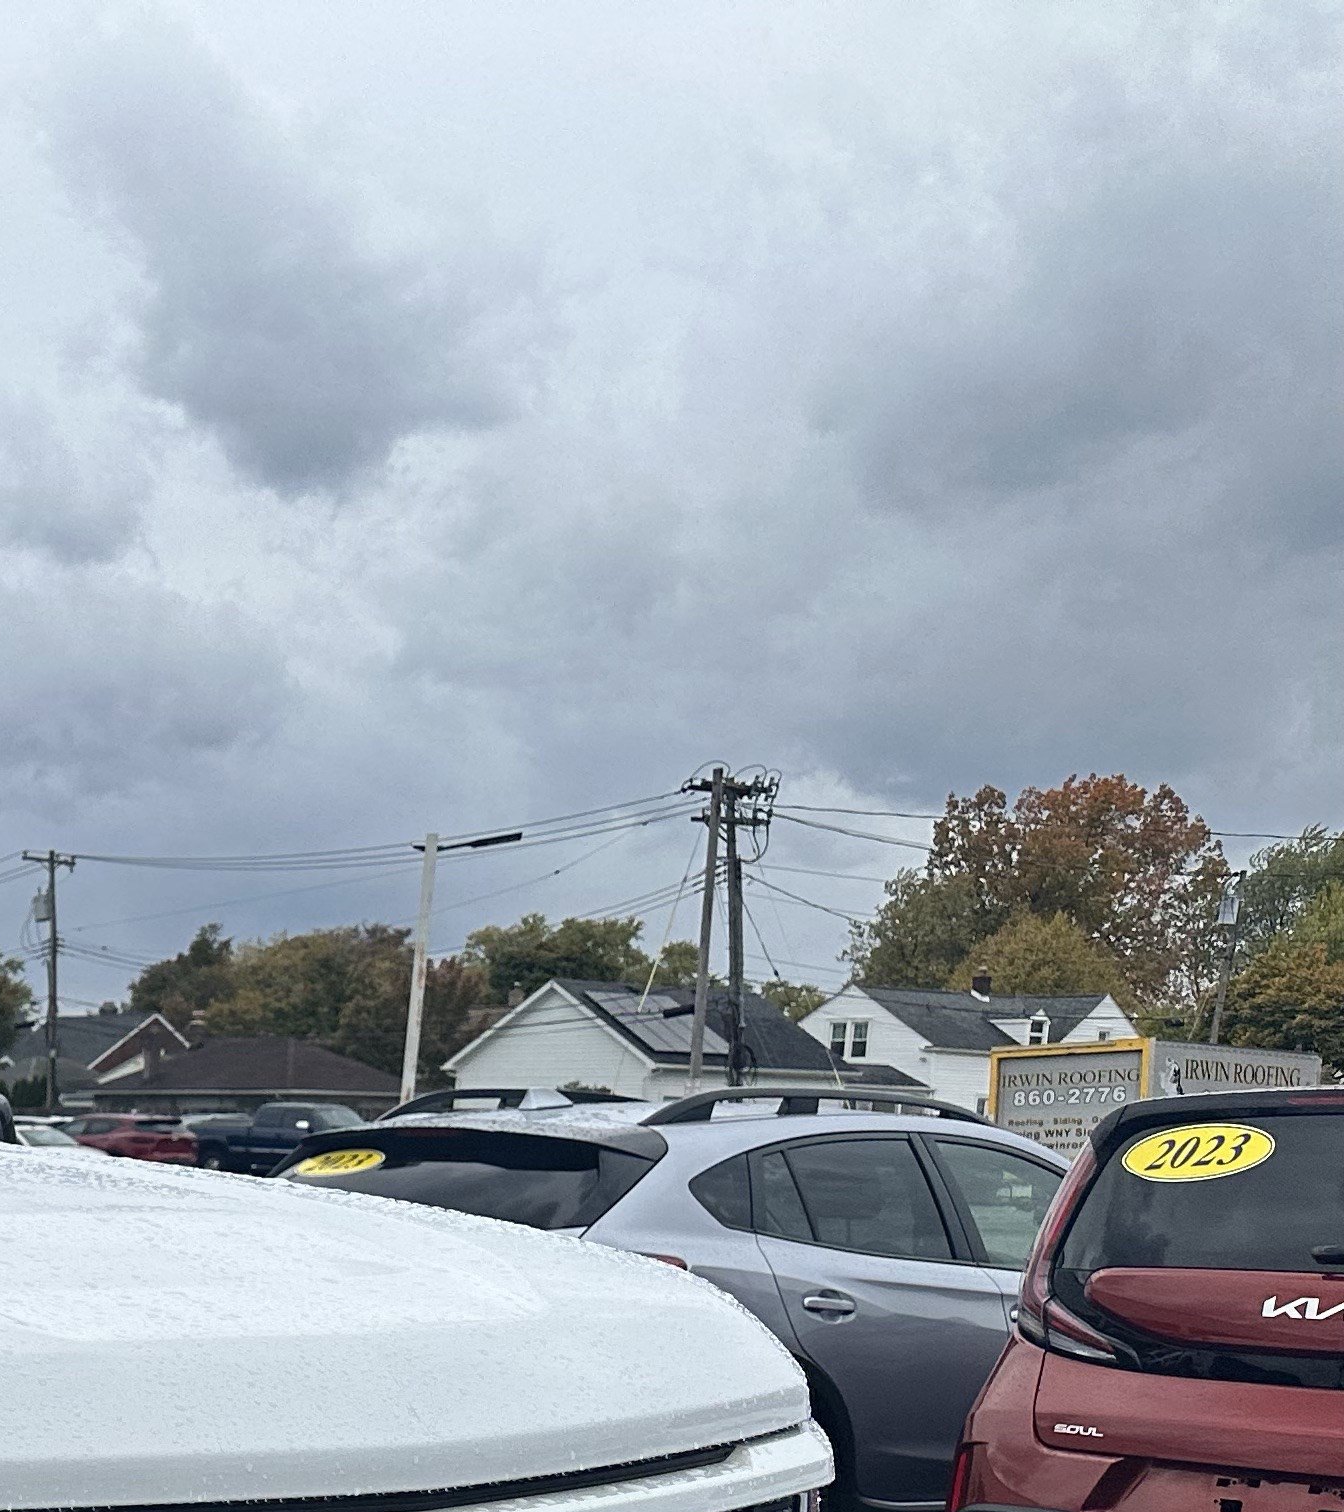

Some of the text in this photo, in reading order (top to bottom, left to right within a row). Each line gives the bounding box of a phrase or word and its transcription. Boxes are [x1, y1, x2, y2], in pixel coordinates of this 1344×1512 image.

[1002, 1068, 1140, 1088] IRWIN ROOFING
[1185, 1058, 1301, 1087] IRWIN ROOFING
[1013, 1086, 1127, 1107] 860-2776
[1144, 1134, 1251, 1172] 2023
[1053, 1423, 1104, 1438] SOUL
